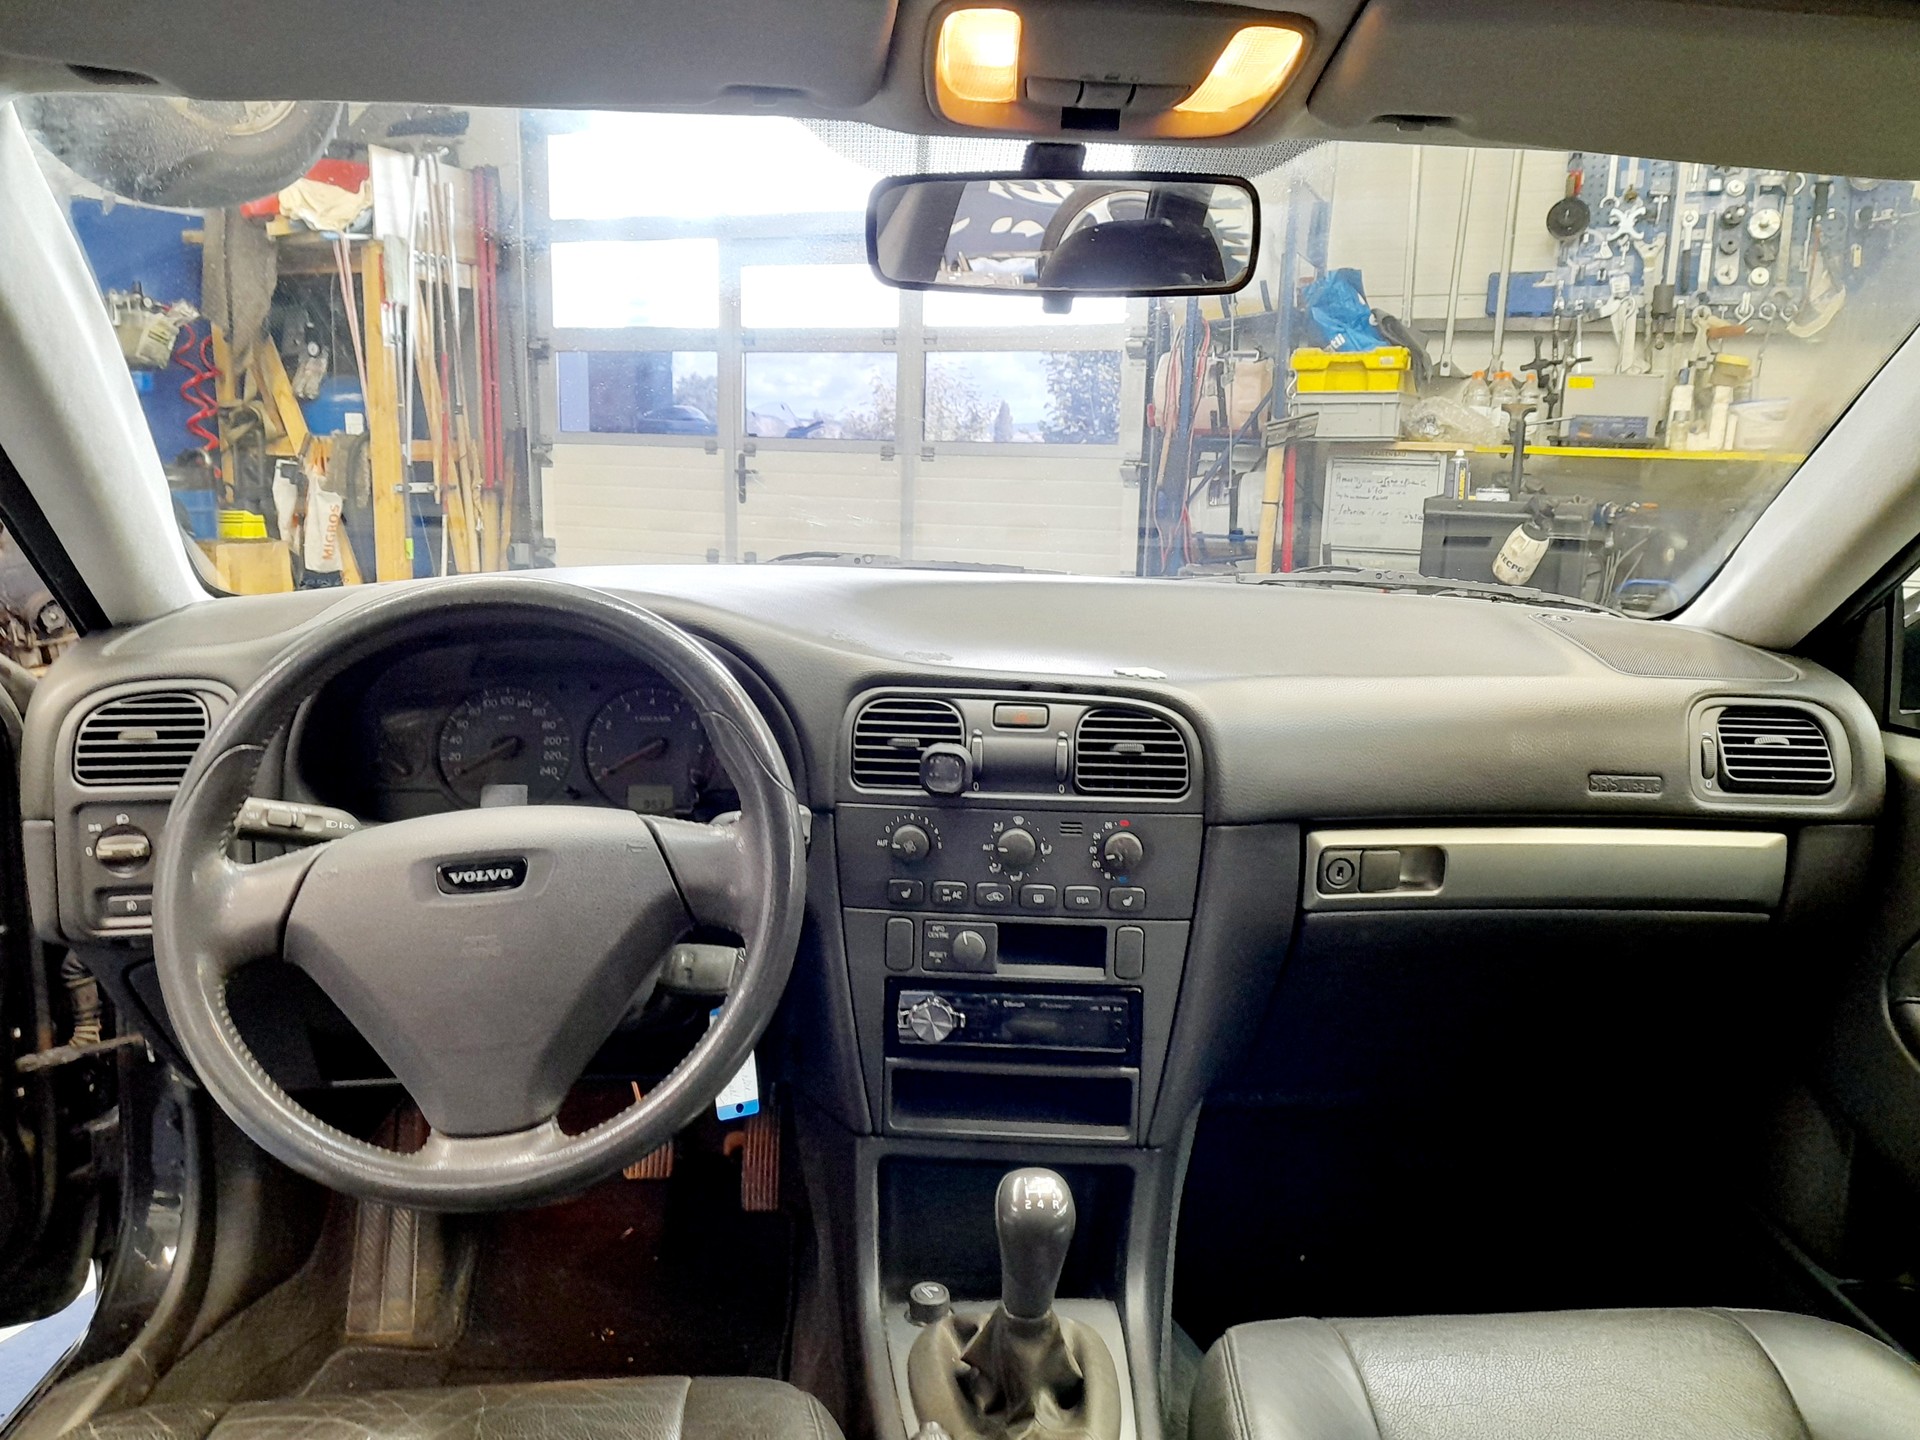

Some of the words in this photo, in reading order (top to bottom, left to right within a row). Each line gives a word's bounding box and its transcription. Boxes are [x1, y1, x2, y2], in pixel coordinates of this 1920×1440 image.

[322, 504, 340, 561] MIGROS
[500, 696, 515, 705] 120
[517, 699, 532, 708] 140
[449, 736, 462, 745] 40
[544, 736, 562, 745] 200
[448, 752, 461, 761] 20
[543, 751, 561, 760] 220
[540, 766, 558, 776] 240
[972, 781, 980, 792] 0
[1590, 775, 1619, 792] SRS
[1058, 783, 1066, 794] 0
[884, 825, 891, 834] 0
[876, 839, 889, 848] AUT
[982, 843, 995, 852] AUT
[85, 846, 94, 857] 0
[449, 868, 515, 885] VOLVO
[952, 890, 962, 900] AC
[1025, 1199, 1032, 1210] 2
[1037, 1199, 1045, 1209] 4
[1052, 1199, 1060, 1210] R
